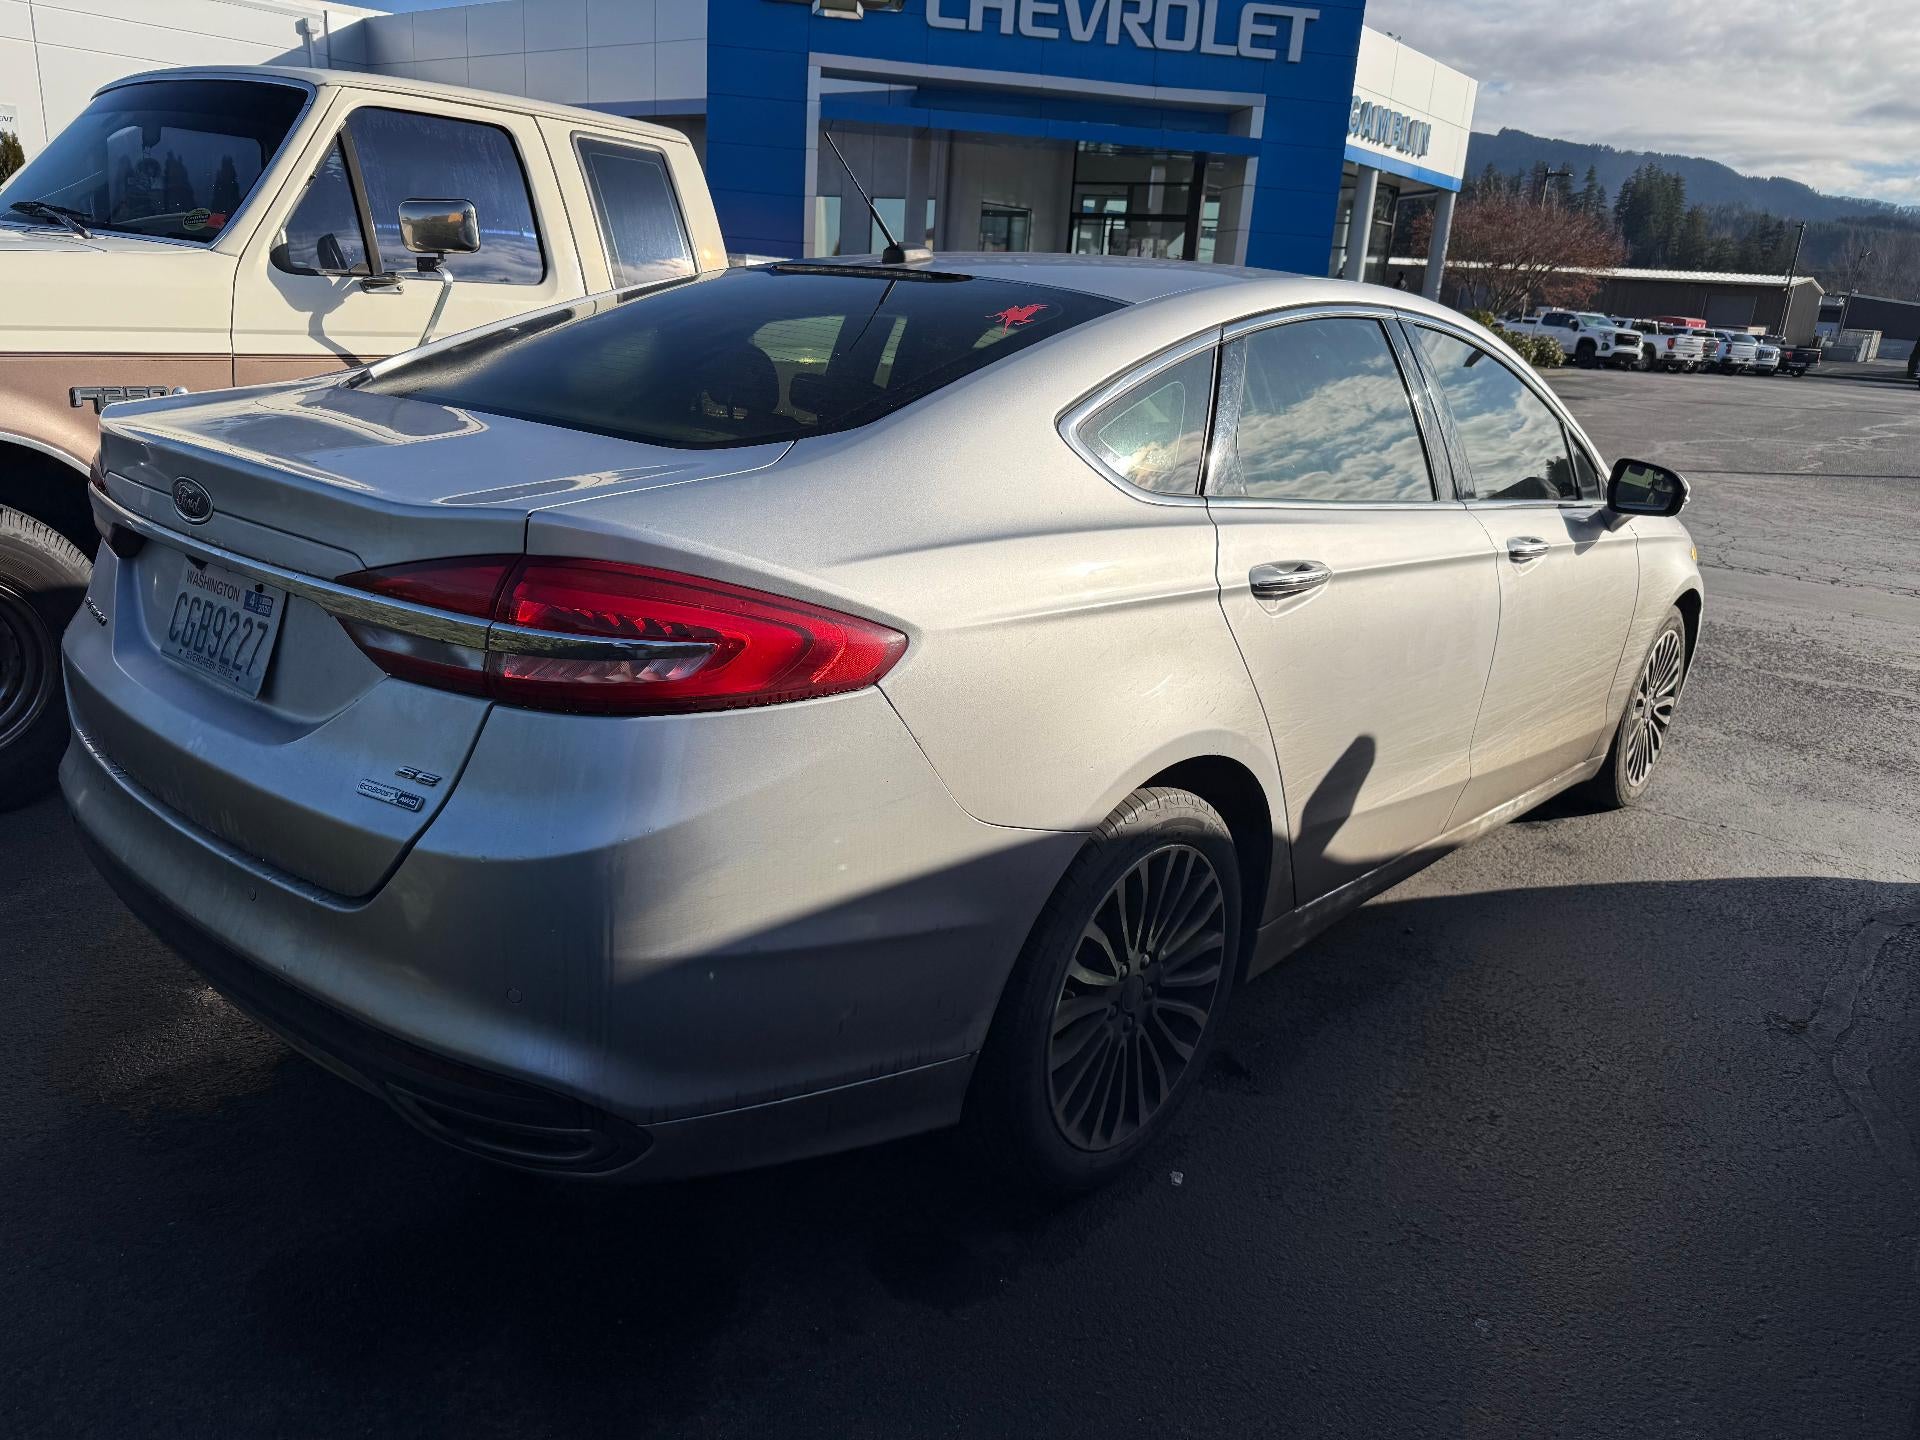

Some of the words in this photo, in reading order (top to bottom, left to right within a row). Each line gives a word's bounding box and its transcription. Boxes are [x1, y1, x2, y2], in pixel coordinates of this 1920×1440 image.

[926, 0, 1320, 63] CHEVROLET
[1349, 96, 1431, 158] GAMBLIN
[186, 569, 241, 602] WASHINGTON
[168, 591, 269, 676] CGB9227
